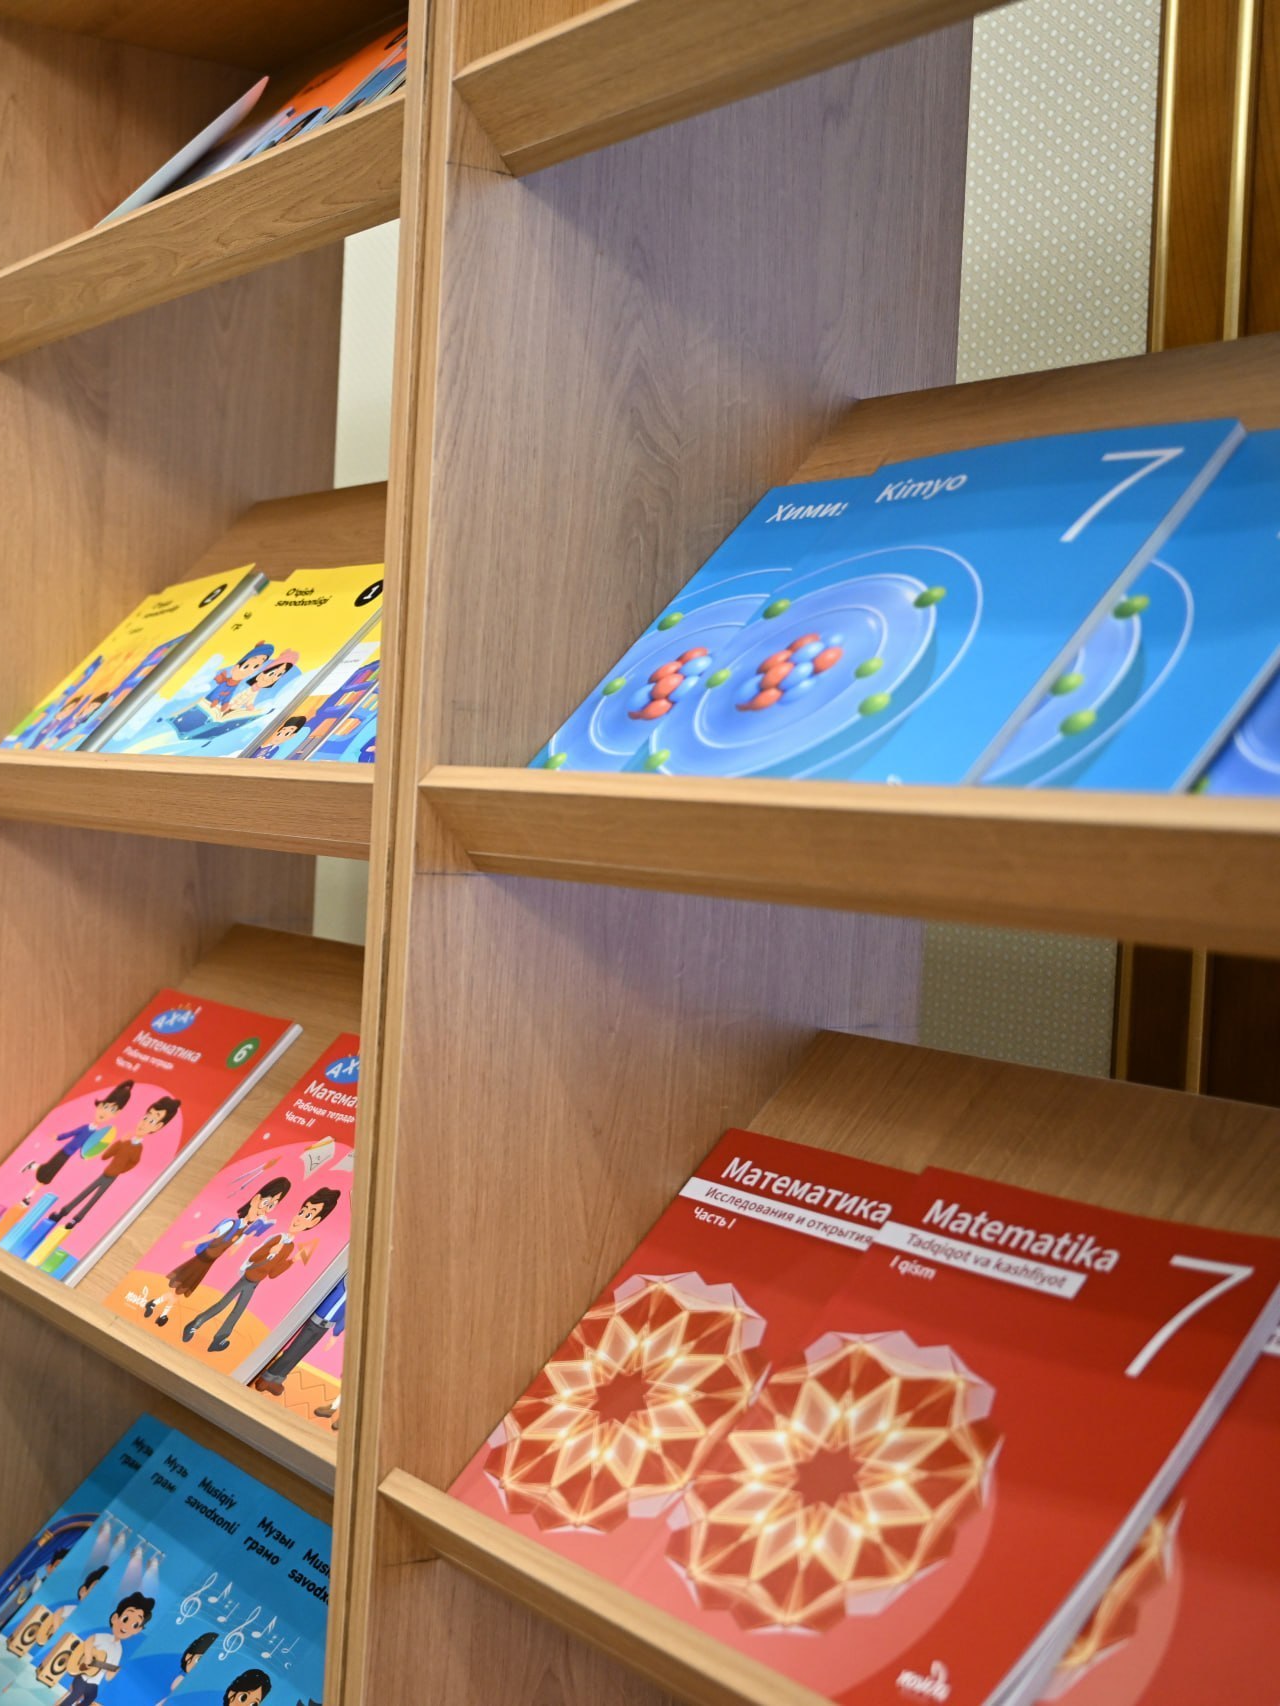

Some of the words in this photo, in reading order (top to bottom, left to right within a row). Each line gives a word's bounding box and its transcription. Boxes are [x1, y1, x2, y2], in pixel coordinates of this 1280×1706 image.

[874, 474, 967, 503] Kimyo
[1059, 447, 1184, 542] 7
[363, 584, 380, 600] 1
[132, 1030, 202, 1063] Математика
[233, 1043, 253, 1063] 6
[325, 1058, 360, 1078] АХ
[285, 1110, 306, 1126] Часть
[305, 1118, 317, 1127] II
[293, 1098, 328, 1117] Рабочая
[327, 1110, 355, 1123] тетрадь
[721, 1156, 893, 1224] Математика
[693, 1206, 727, 1229] Часть
[727, 1218, 737, 1230] I
[704, 1186, 795, 1222] Исследования
[795, 1213, 805, 1225] и
[806, 1218, 873, 1245] открытия
[922, 1199, 1120, 1274] Matematika
[889, 1255, 901, 1269] I
[897, 1258, 937, 1281] qism
[905, 1232, 971, 1261] Tadqiqot
[972, 1253, 992, 1267] va
[992, 1257, 1068, 1289] kashfiyot
[1123, 1254, 1255, 1379] 7
[198, 1476, 238, 1511] Musiqiy
[288, 1568, 330, 1605] savodx
